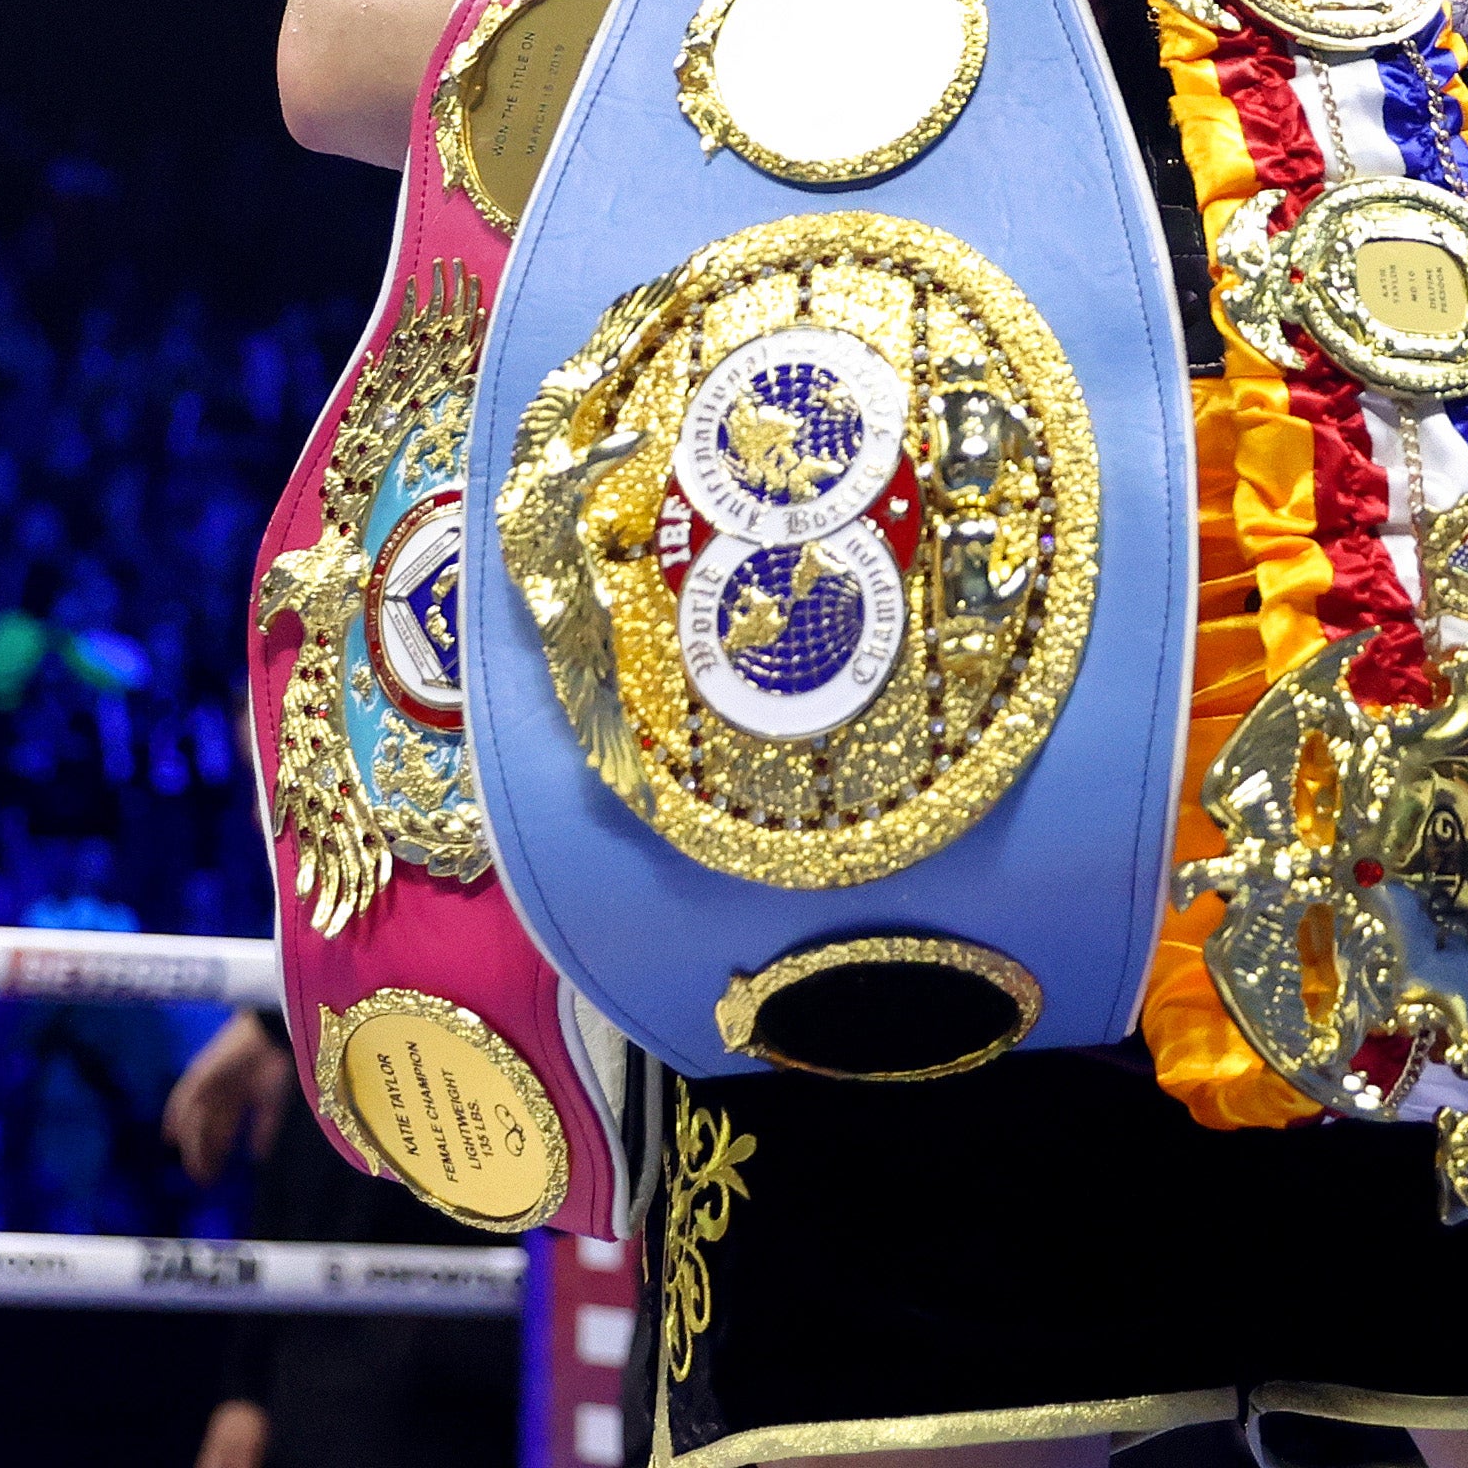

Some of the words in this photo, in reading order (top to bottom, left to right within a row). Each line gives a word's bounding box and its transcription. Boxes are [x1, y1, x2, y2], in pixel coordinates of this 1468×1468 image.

[492, 125, 509, 157] WON
[502, 96, 518, 120] THE
[511, 56, 529, 90] TITLE
[522, 31, 536, 51] ON
[526, 103, 548, 156] MARCH
[658, 494, 693, 569] IBF
[686, 563, 735, 679] World
[378, 1054, 405, 1110] TAYLOR
[406, 1041, 439, 1120] CHAMPION
[396, 1115, 419, 1156] KATIE
[431, 1124, 459, 1182] FEMALE
[442, 1070, 482, 1170] LIGHTWEIGHT
